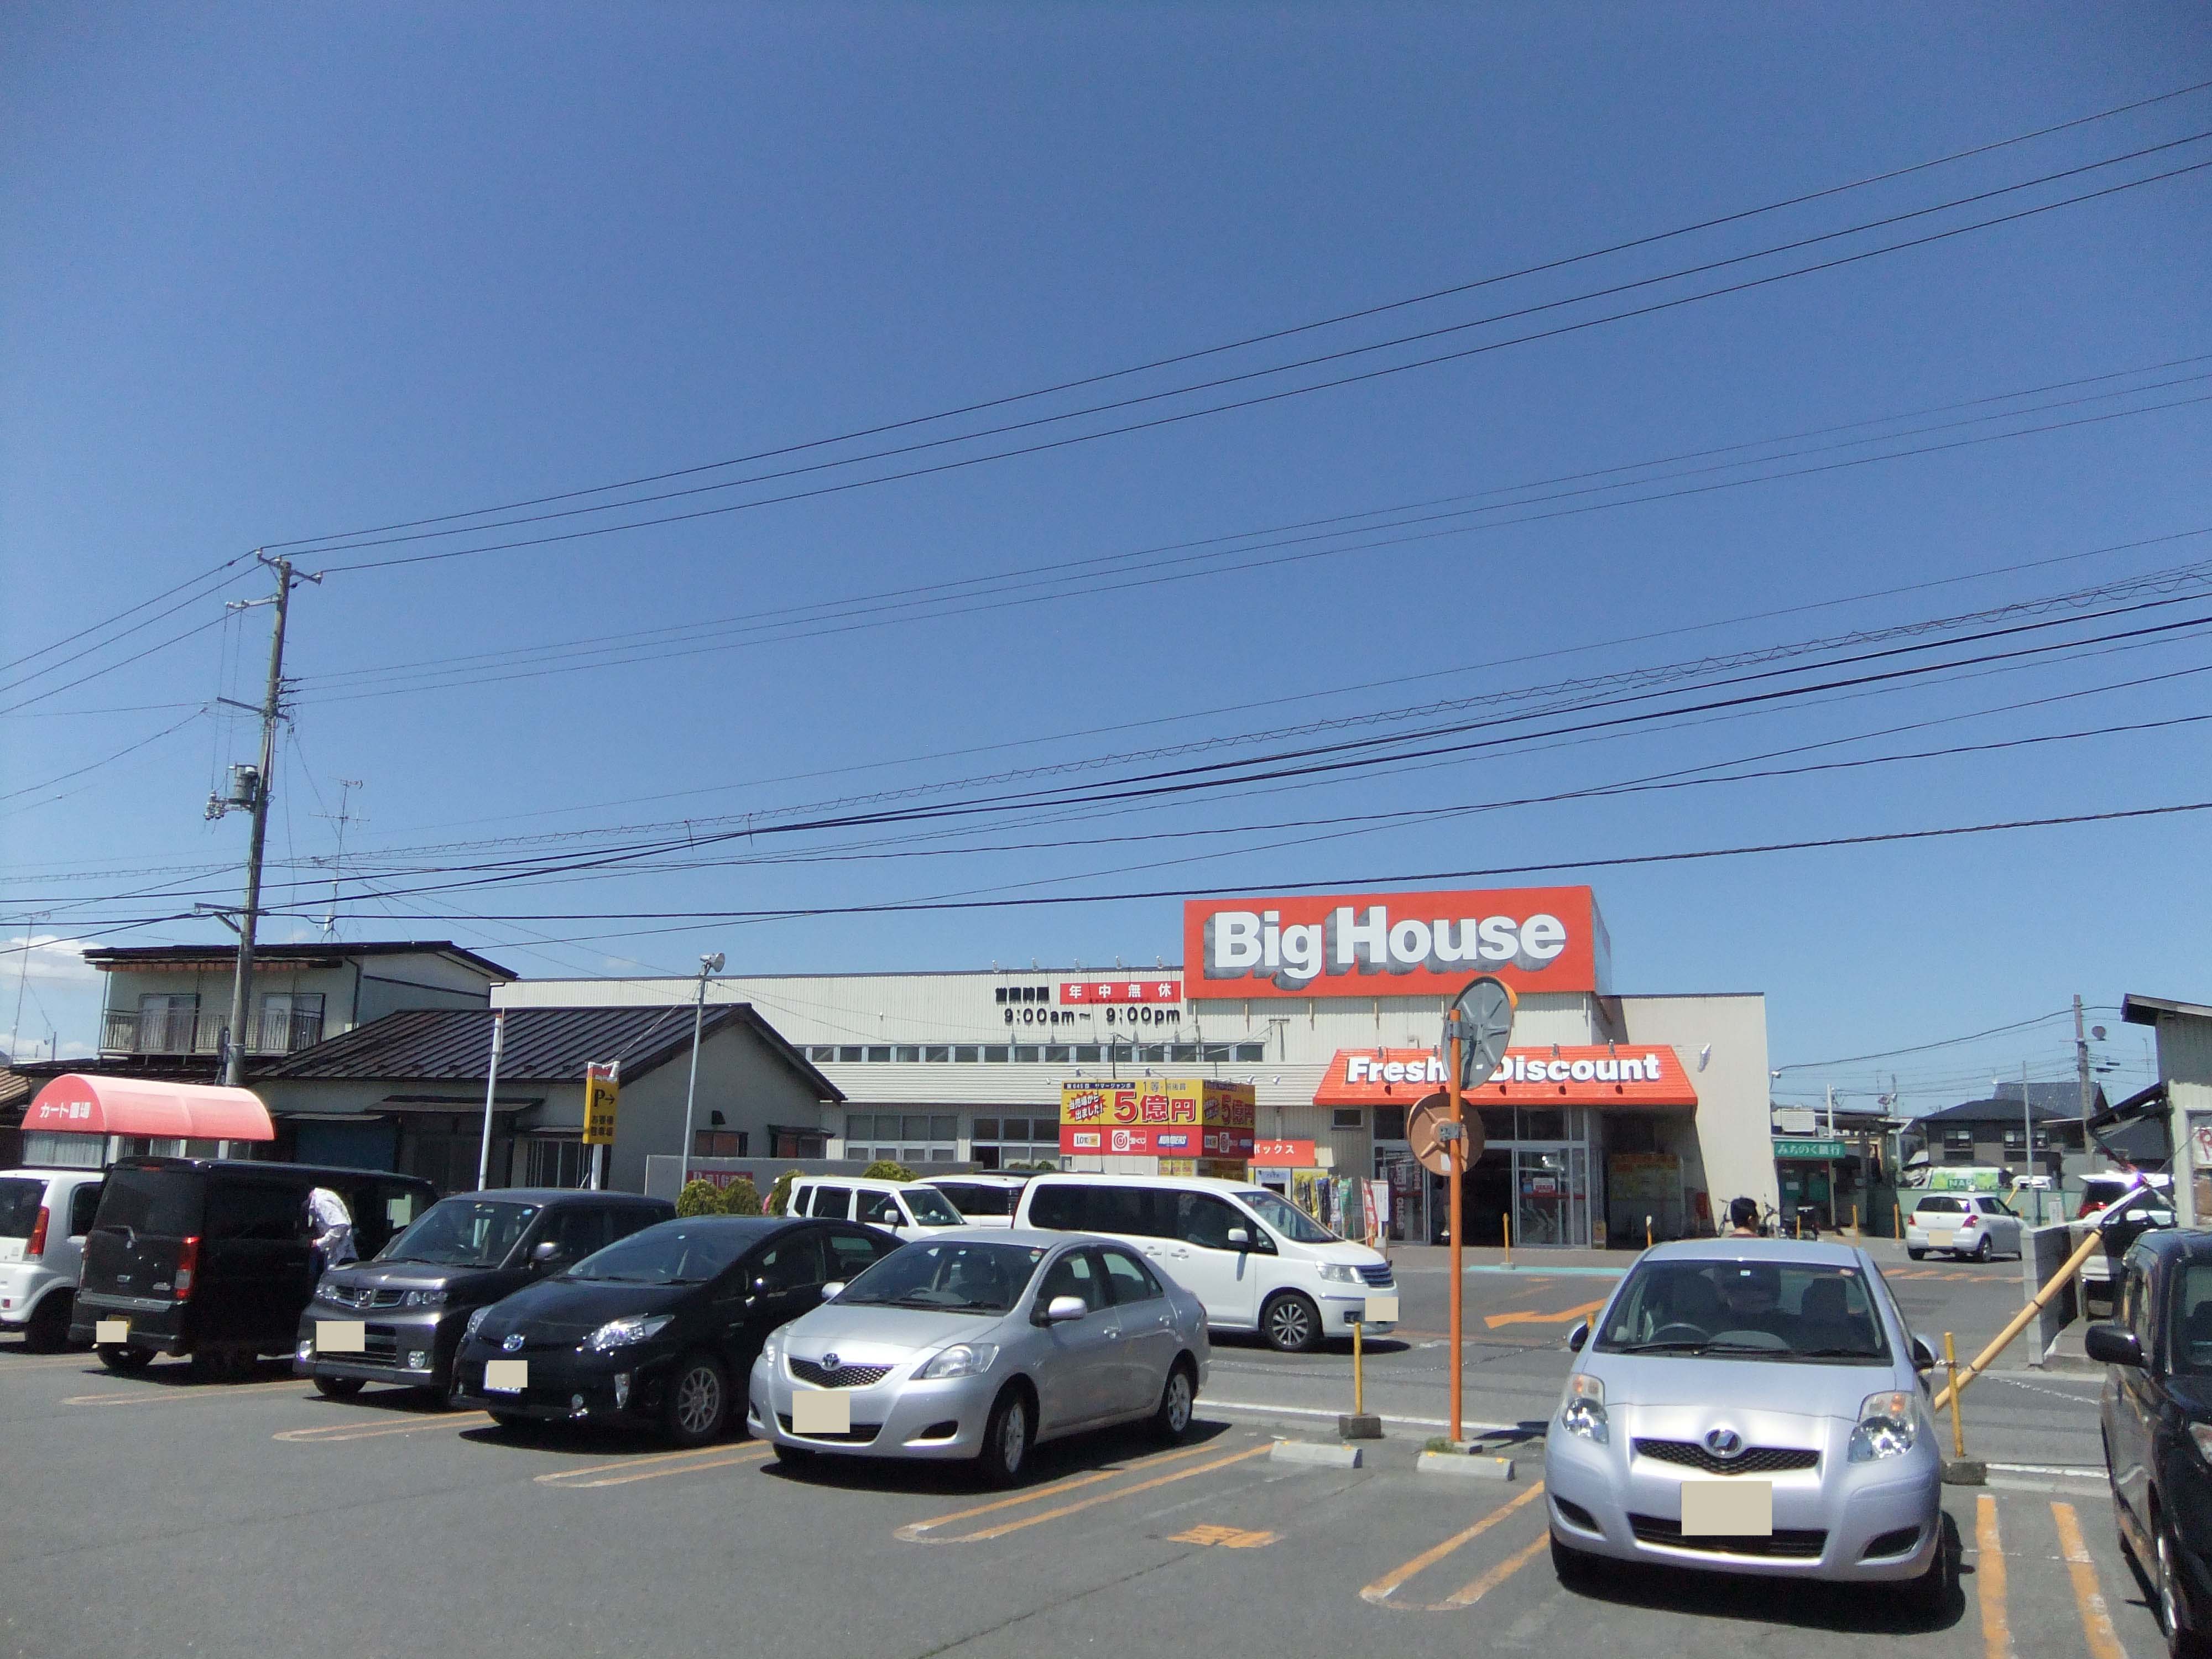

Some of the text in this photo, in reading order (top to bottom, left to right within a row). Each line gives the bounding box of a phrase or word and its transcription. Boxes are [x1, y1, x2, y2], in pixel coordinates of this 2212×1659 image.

[1214, 905, 1567, 979] Big House
[1069, 983, 1172, 999] 年中無休
[1105, 1006, 1181, 1026] 9:00pm
[1347, 1057, 1447, 1082] Fresh
[594, 1089, 606, 1107] P
[1113, 1091, 1196, 1123] 5億円
